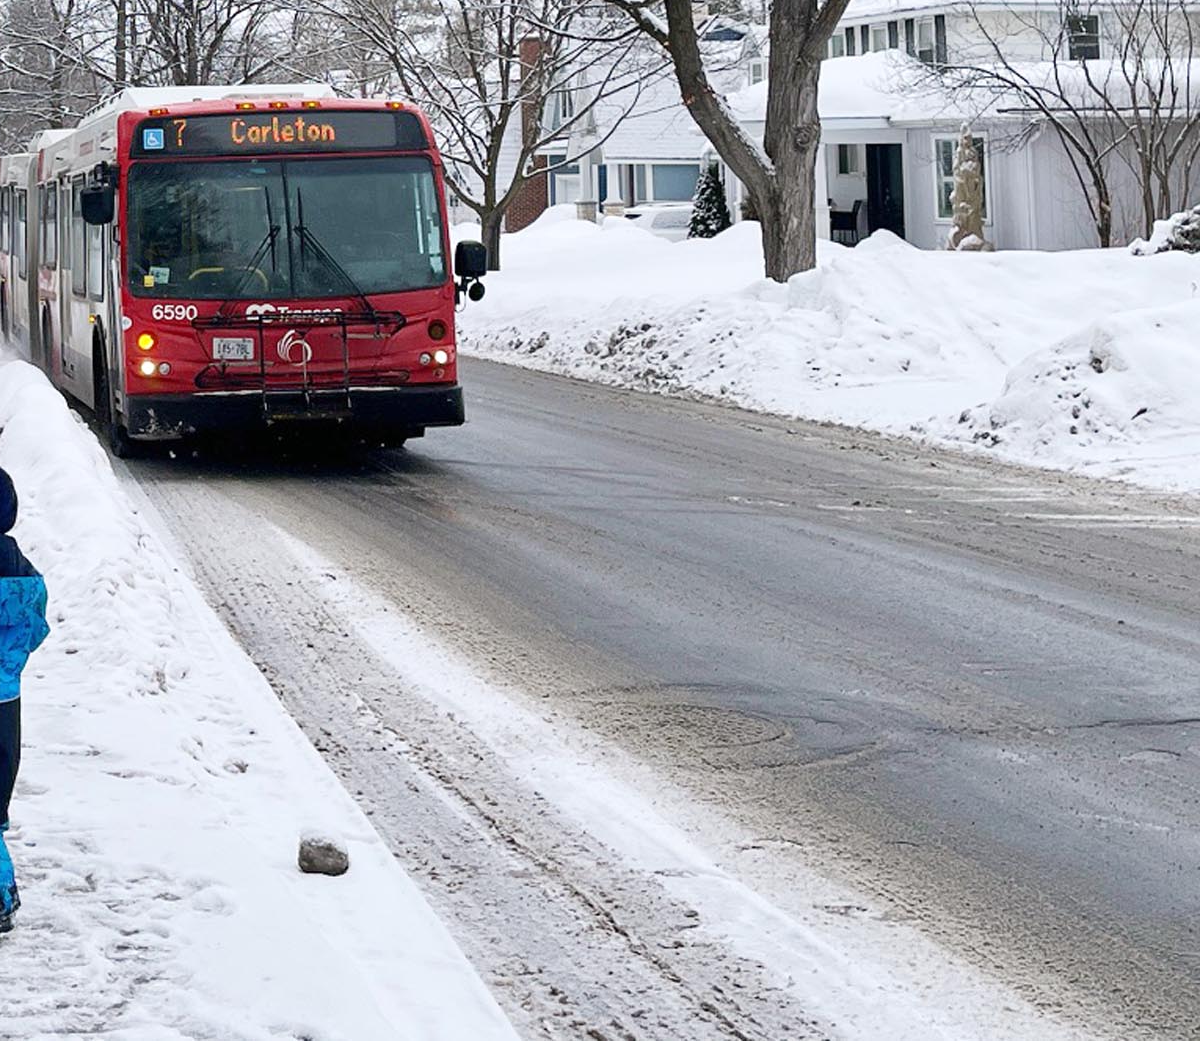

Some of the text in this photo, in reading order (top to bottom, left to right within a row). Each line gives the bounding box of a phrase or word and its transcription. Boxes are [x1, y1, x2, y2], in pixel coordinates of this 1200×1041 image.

[173, 116, 336, 147] 7 Carleton
[152, 304, 198, 321] 6590
